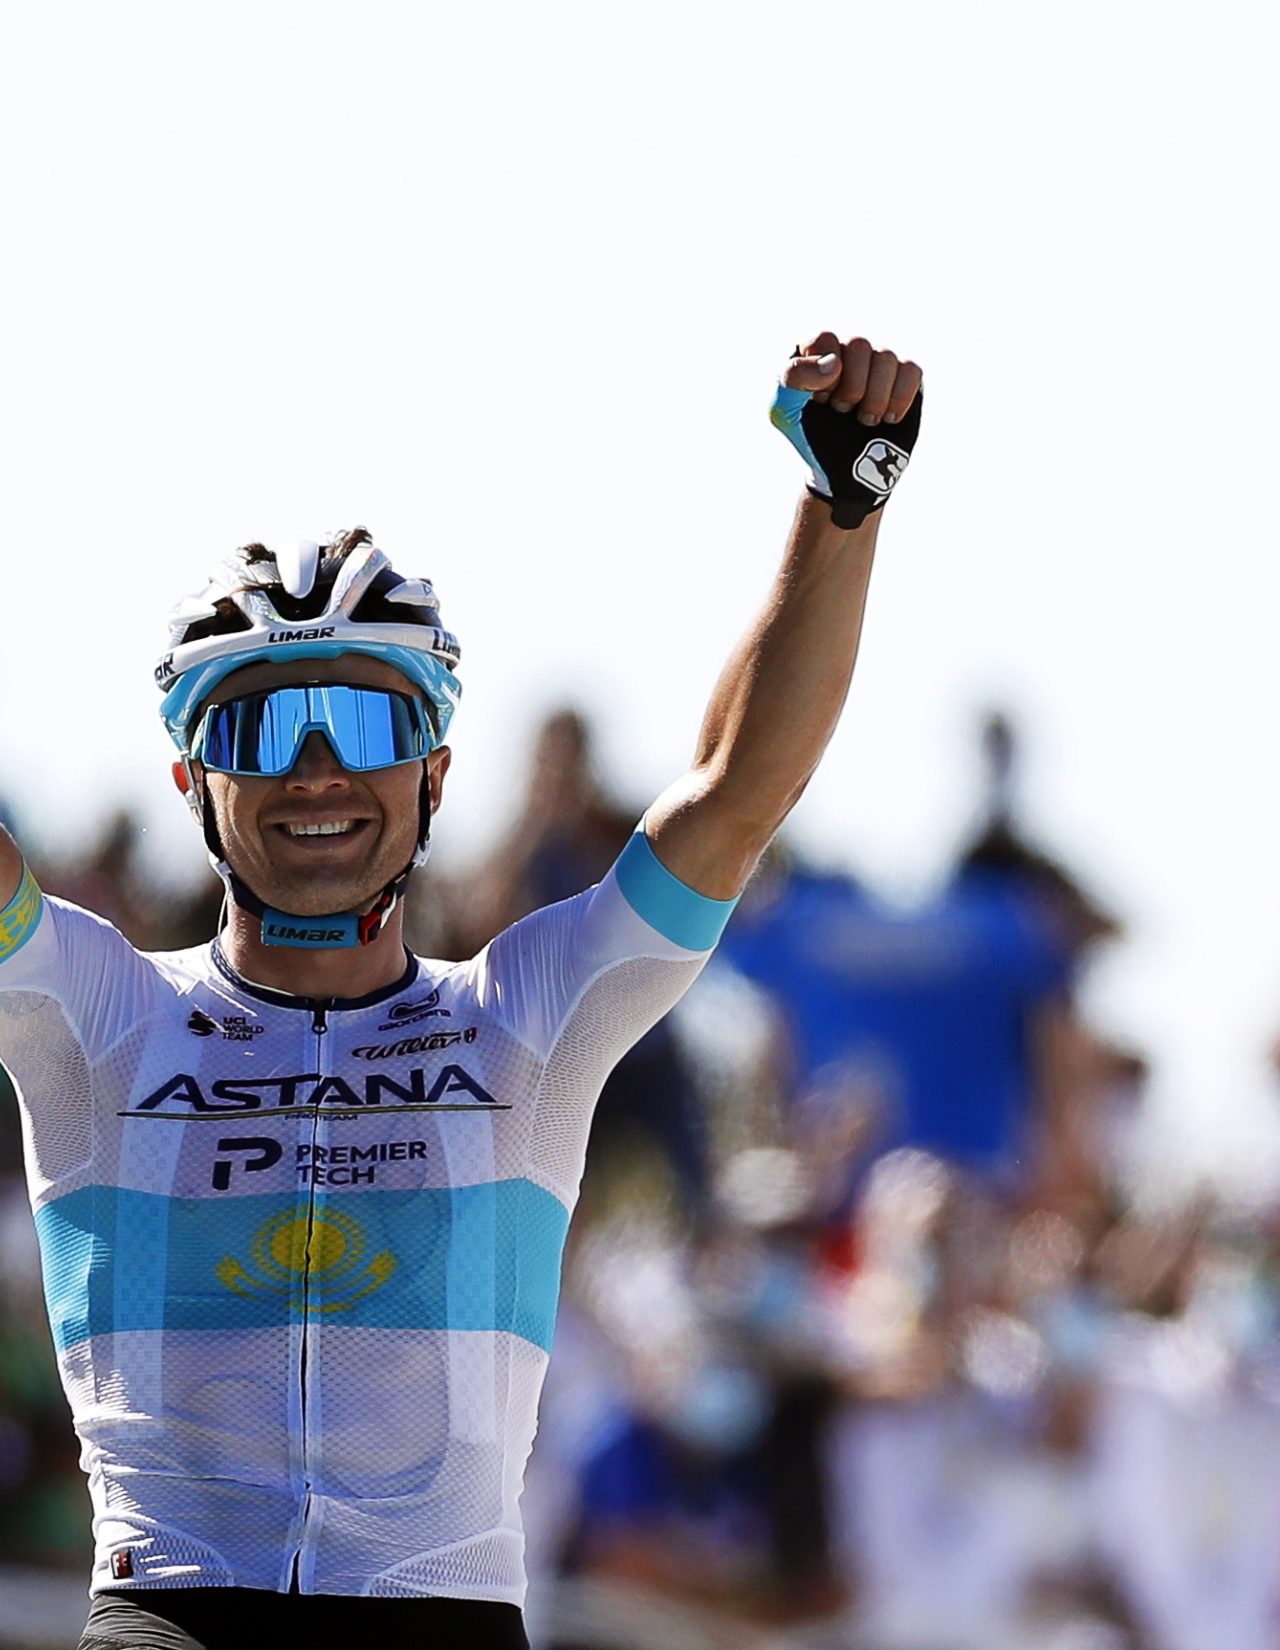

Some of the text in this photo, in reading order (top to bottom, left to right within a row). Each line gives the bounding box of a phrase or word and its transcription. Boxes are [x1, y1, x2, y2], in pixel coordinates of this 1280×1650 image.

[223, 1016, 246, 1025] UCI
[223, 1025, 265, 1035] WORLD
[223, 1032, 253, 1042] TEAM
[135, 1064, 497, 1112] ASTANA
[296, 1140, 428, 1164] PREMIER
[296, 1164, 376, 1186] TECH
